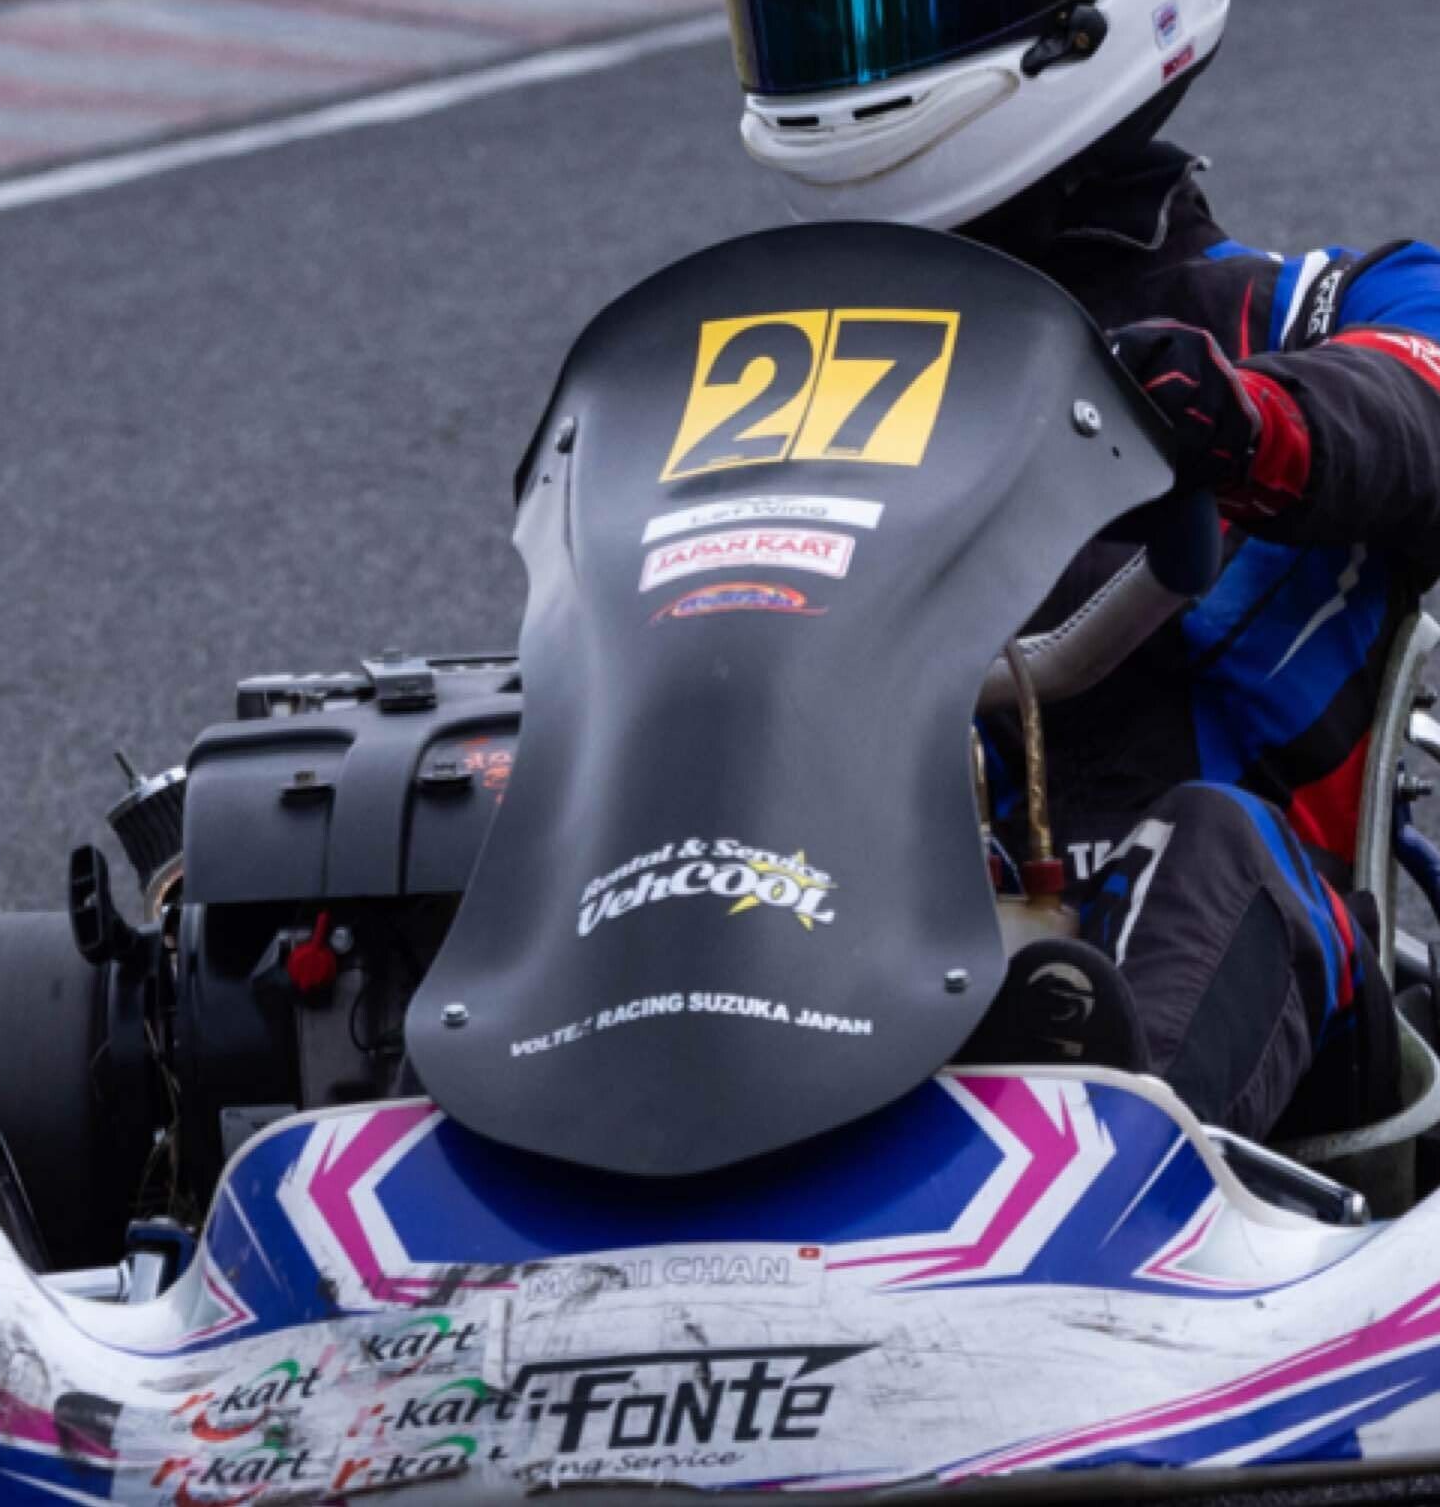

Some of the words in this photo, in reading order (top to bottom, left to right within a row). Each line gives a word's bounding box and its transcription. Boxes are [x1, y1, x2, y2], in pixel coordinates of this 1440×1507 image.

[670, 320, 950, 476] 27
[656, 539, 748, 572] JAPAN
[756, 533, 834, 559] KART
[581, 842, 673, 906] Rental
[677, 836, 707, 860] &
[595, 992, 684, 1031] RACING
[686, 991, 790, 1023] SUZUKA
[794, 1008, 874, 1036] JAPAN
[665, 1256, 791, 1287] CHAN
